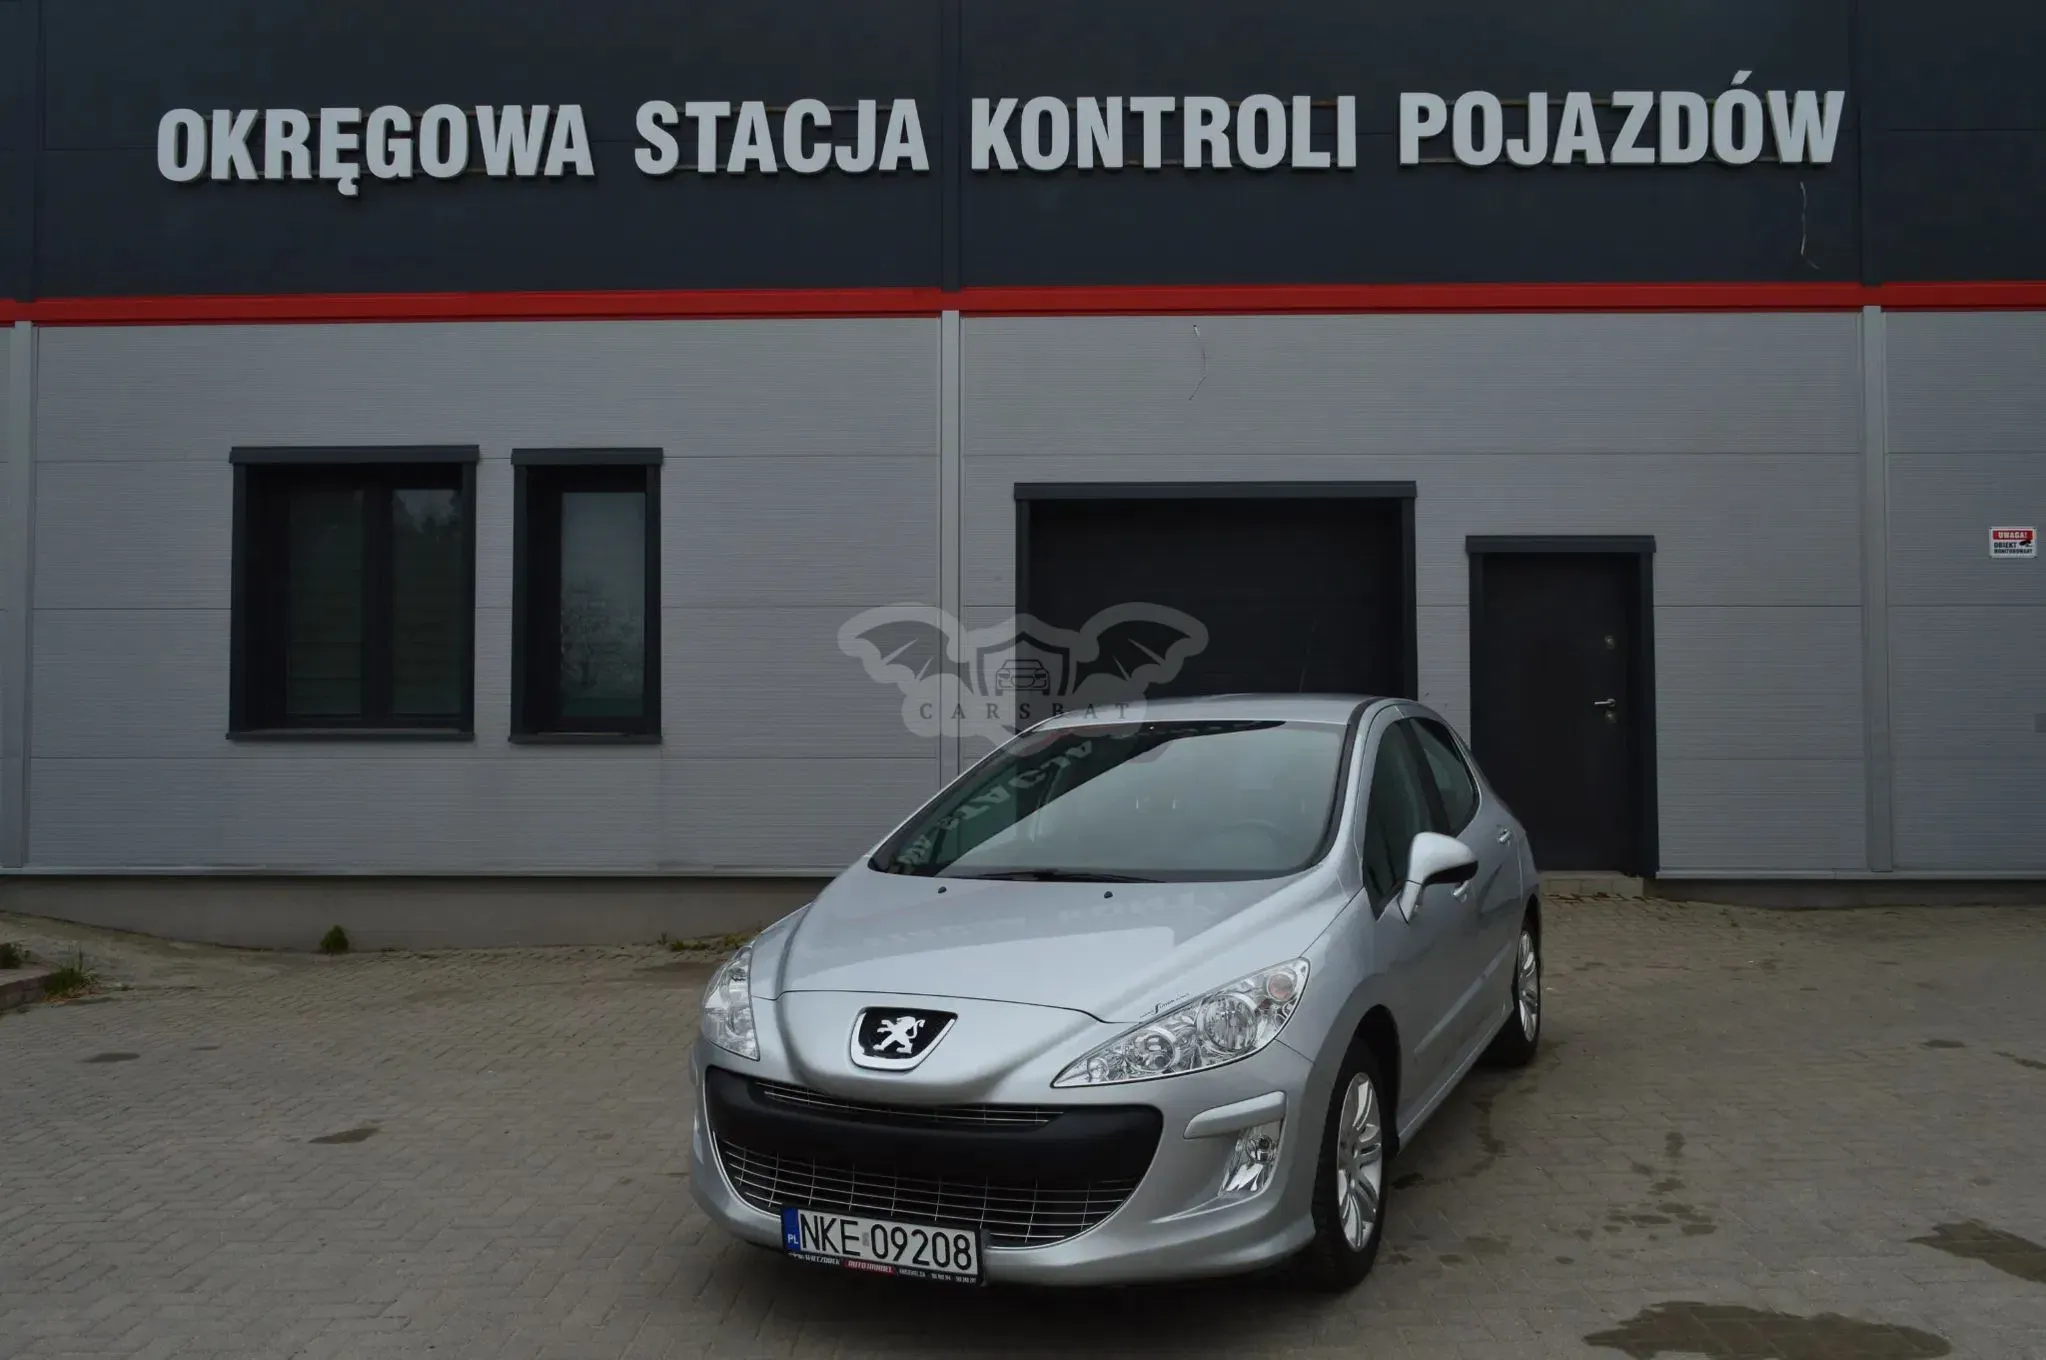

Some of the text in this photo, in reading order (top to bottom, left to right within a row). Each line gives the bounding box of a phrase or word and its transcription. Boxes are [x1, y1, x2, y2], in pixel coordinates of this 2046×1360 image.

[157, 70, 1846, 197] OKRĘGOWA STACJA KONTROLI POJAZDÓW
[1998, 531, 2028, 539] UWAGA!
[787, 1233, 799, 1245] PL
[800, 1213, 972, 1271] NKE 09208
